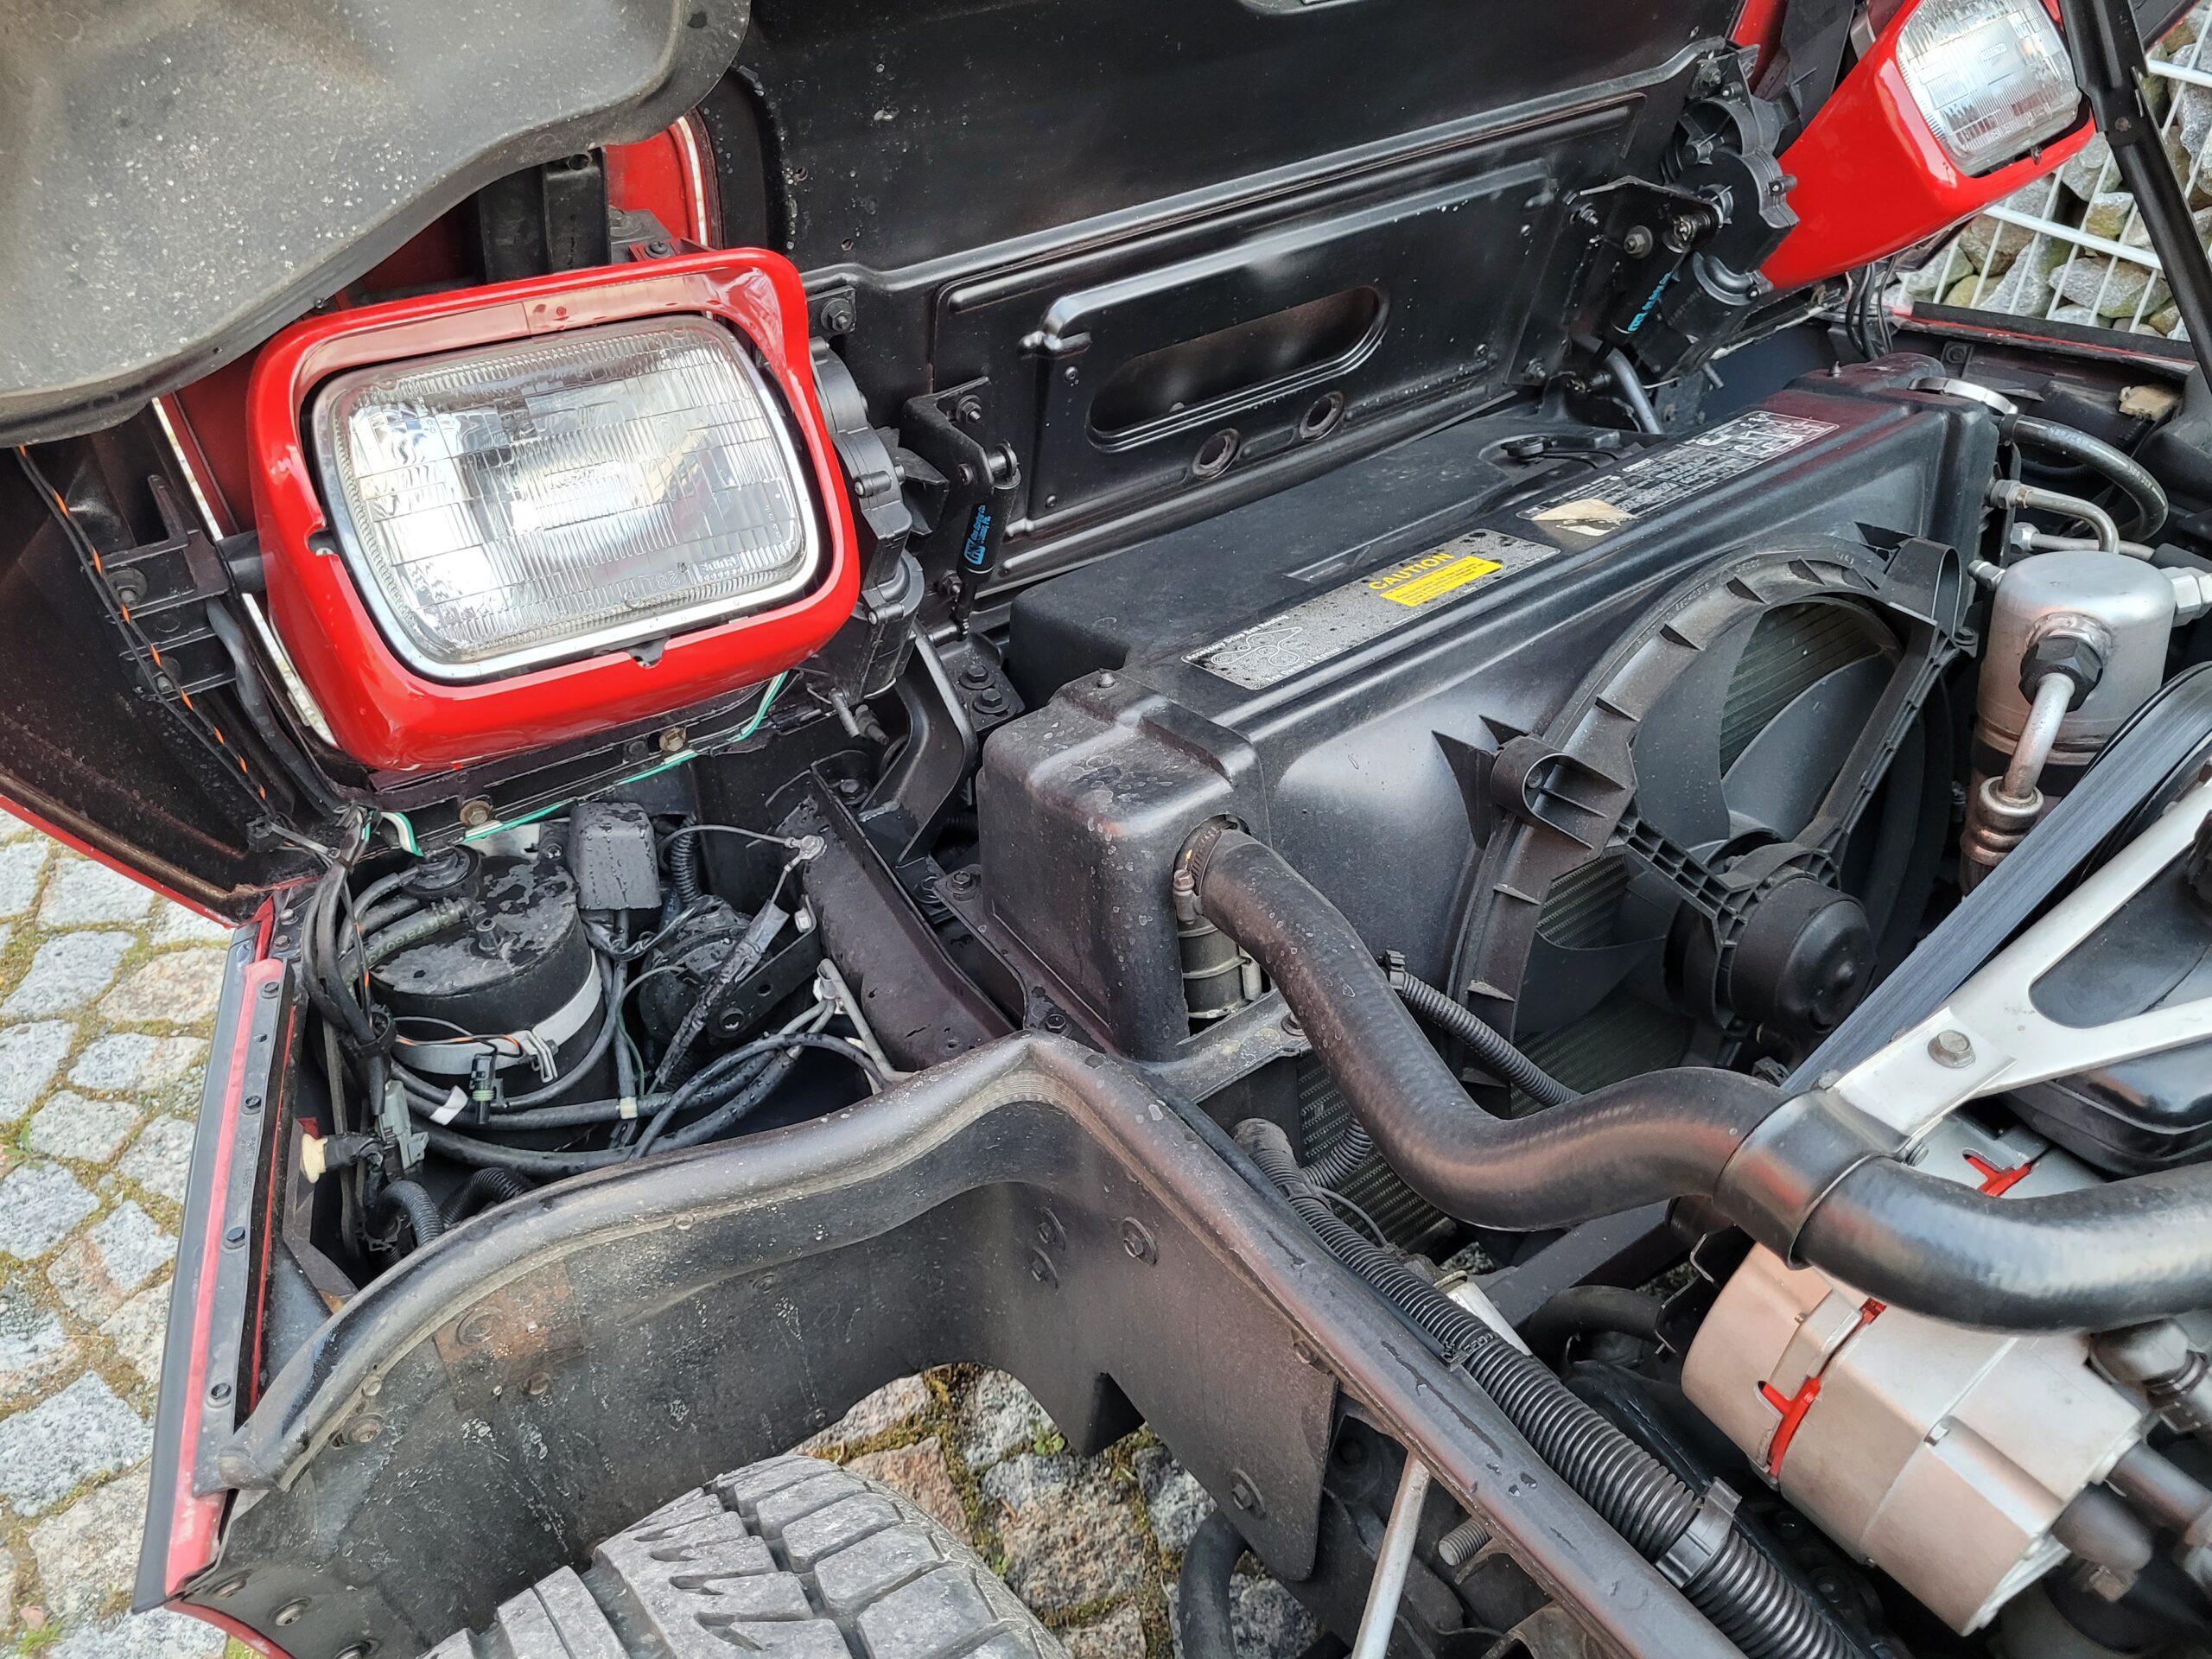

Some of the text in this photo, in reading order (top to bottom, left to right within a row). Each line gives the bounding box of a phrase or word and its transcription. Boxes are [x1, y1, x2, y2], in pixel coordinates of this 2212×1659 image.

[1369, 552, 1455, 591] CAUTION
[1185, 614, 1290, 661] Accessory Drive Belt Routing
[1313, 647, 1343, 662] Manual
